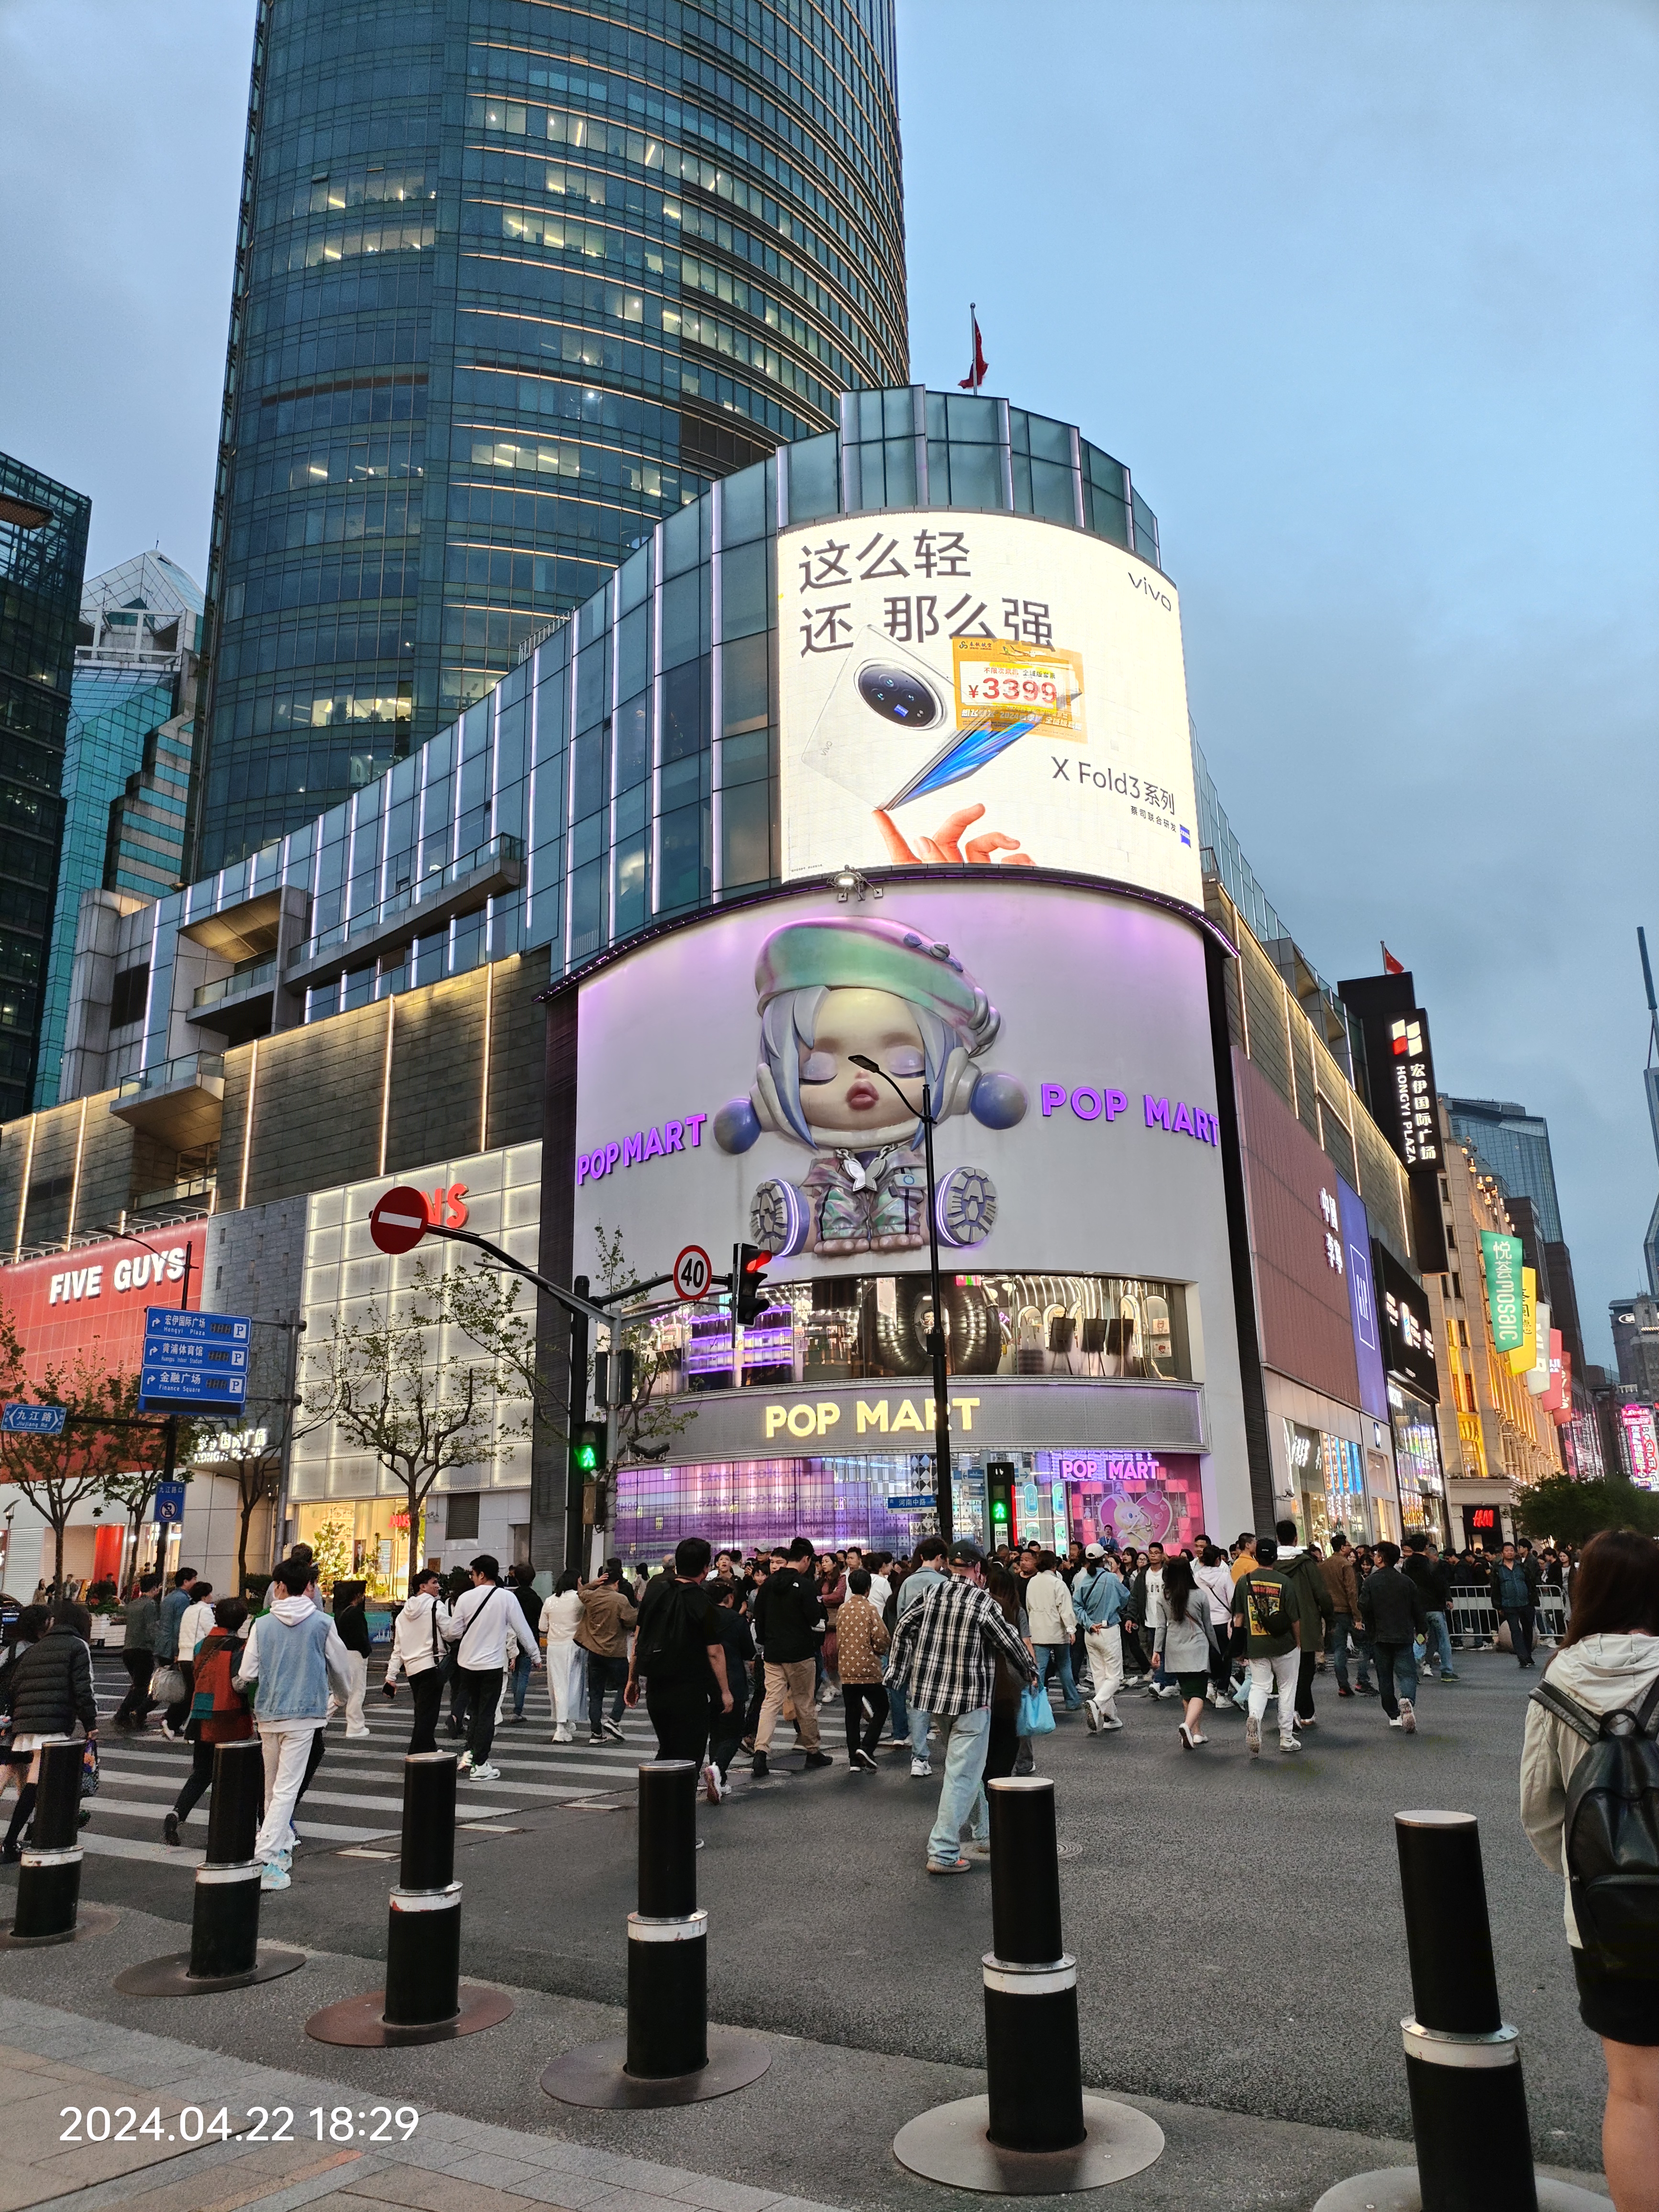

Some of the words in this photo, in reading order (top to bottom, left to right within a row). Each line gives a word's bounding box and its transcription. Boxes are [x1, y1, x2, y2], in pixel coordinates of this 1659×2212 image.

[799, 529, 972, 594] 这么轻
[1128, 571, 1172, 612] vivo
[800, 603, 853, 658] 还
[884, 593, 1056, 652] 那么强
[1051, 756, 1070, 781] X
[1131, 806, 1177, 832] 蔡司联合研发
[1396, 1065, 1411, 1116] HONGYI
[1041, 1084, 1128, 1121] POP
[1143, 1095, 1218, 1147] MART
[1410, 1063, 1436, 1160] 宏伊国际广场
[577, 1142, 621, 1185] POP
[623, 1114, 707, 1167] MART
[1403, 1121, 1416, 1164] PLAZA
[420, 1183, 469, 1228] NS
[49, 1265, 103, 1304] FIVE
[114, 1247, 187, 1291] GUYS
[681, 1259, 704, 1287] 40
[165, 1315, 206, 1328] 宏伊国际广场
[236, 1326, 243, 1336] P
[162, 1342, 203, 1357] 黄浦体育馆
[234, 1353, 242, 1363] P
[160, 1371, 201, 1384] 金融广场
[232, 1381, 240, 1391] P
[17, 1410, 52, 1422] 九江路
[765, 1403, 840, 1438] POP
[1060, 1460, 1097, 1479] POP
[1106, 1461, 1160, 1480] MART
[899, 1498, 926, 1506] 河南中路
